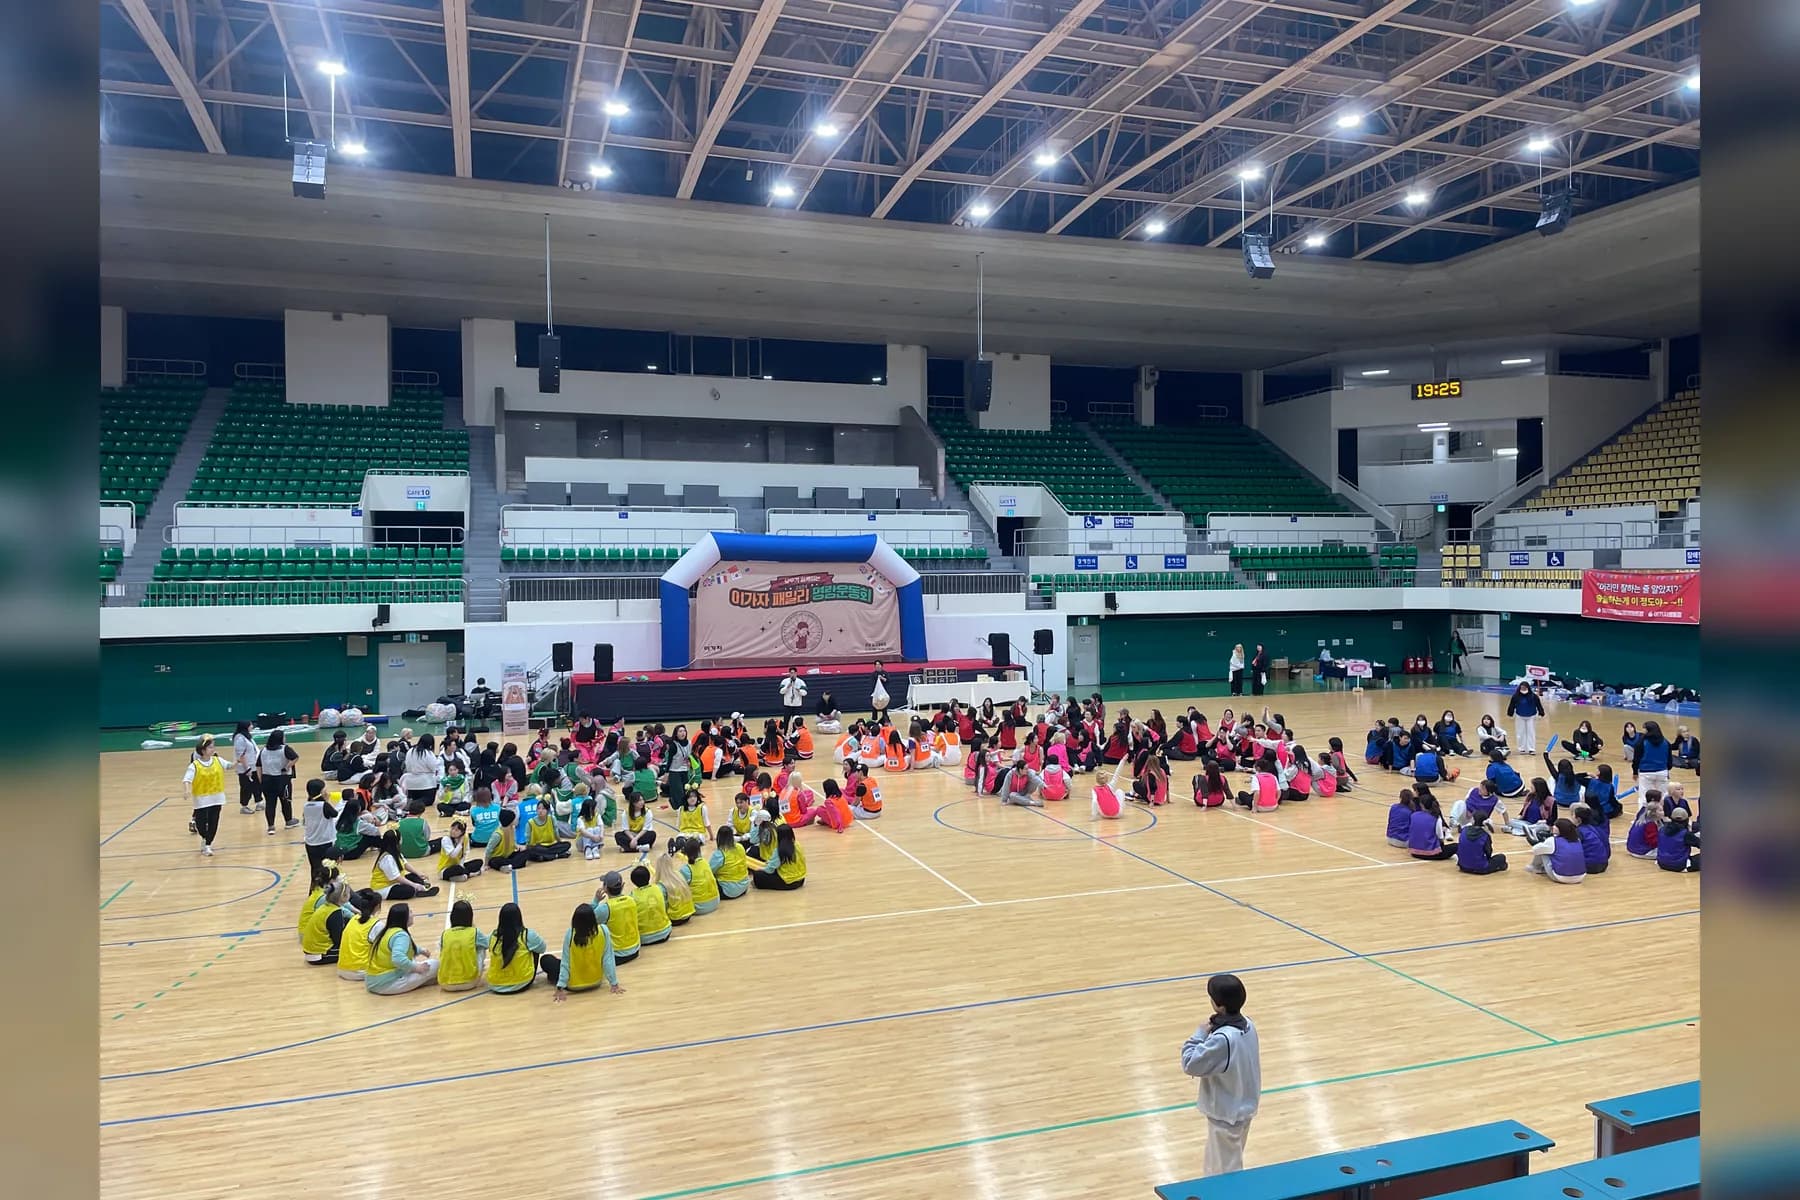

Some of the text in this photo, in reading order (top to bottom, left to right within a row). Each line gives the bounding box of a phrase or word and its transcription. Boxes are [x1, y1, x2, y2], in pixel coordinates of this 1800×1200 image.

[1416, 382, 1460, 398] 19:25
[731, 584, 873, 607] 이가자 패밀리 명랑운동회
[1631, 597, 1639, 606] 이
